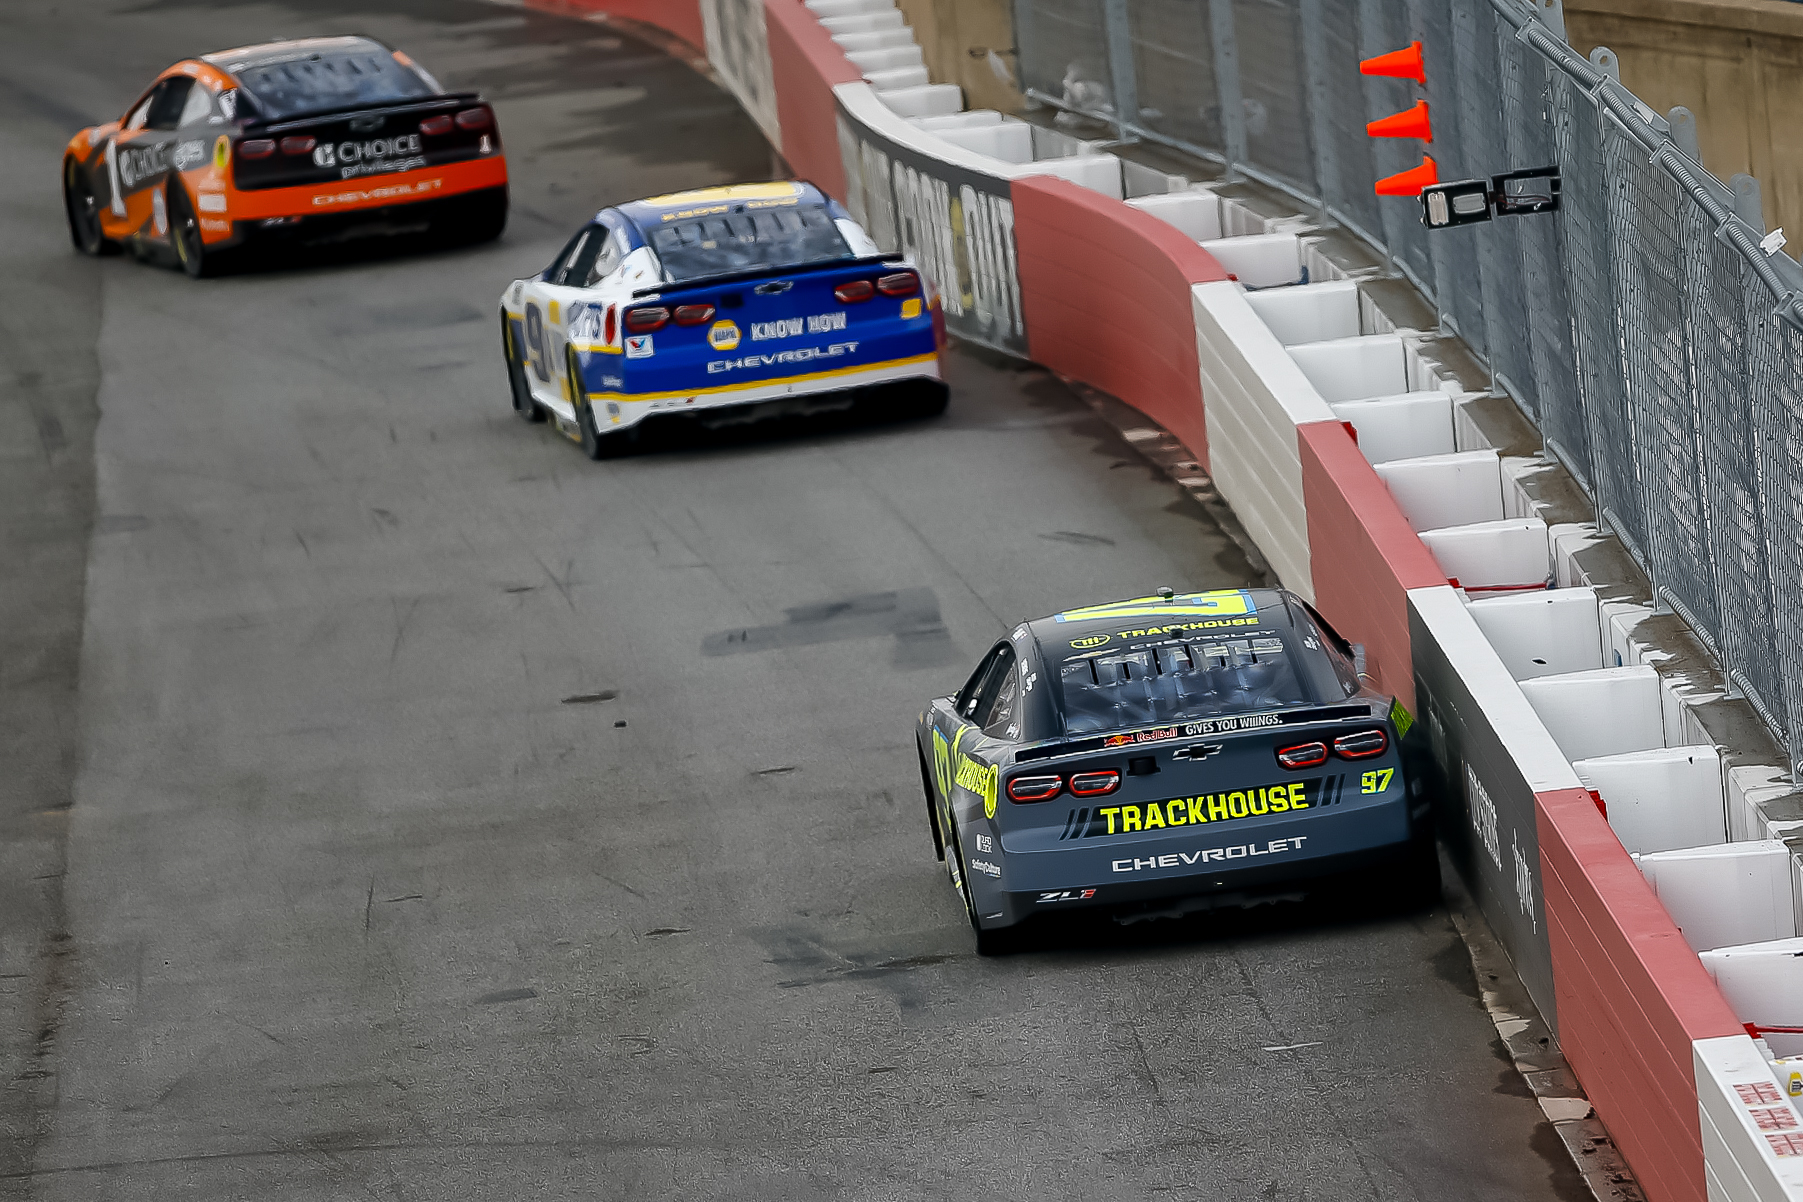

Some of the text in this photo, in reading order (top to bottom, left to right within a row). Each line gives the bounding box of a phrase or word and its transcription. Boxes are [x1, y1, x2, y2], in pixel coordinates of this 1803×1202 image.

[338, 133, 422, 162] CHOICE
[312, 178, 443, 206] CHEVROLET
[751, 318, 803, 341] KNOW
[707, 341, 859, 374] CHEVROLET
[1117, 617, 1260, 639] TRACKHOUSE
[1185, 723, 1214, 736] GIVES
[1216, 720, 1237, 731] YOU
[1361, 767, 1394, 794] 97
[1100, 783, 1309, 834] TRACKHOUSE
[1111, 836, 1307, 873] CHEVROLET
